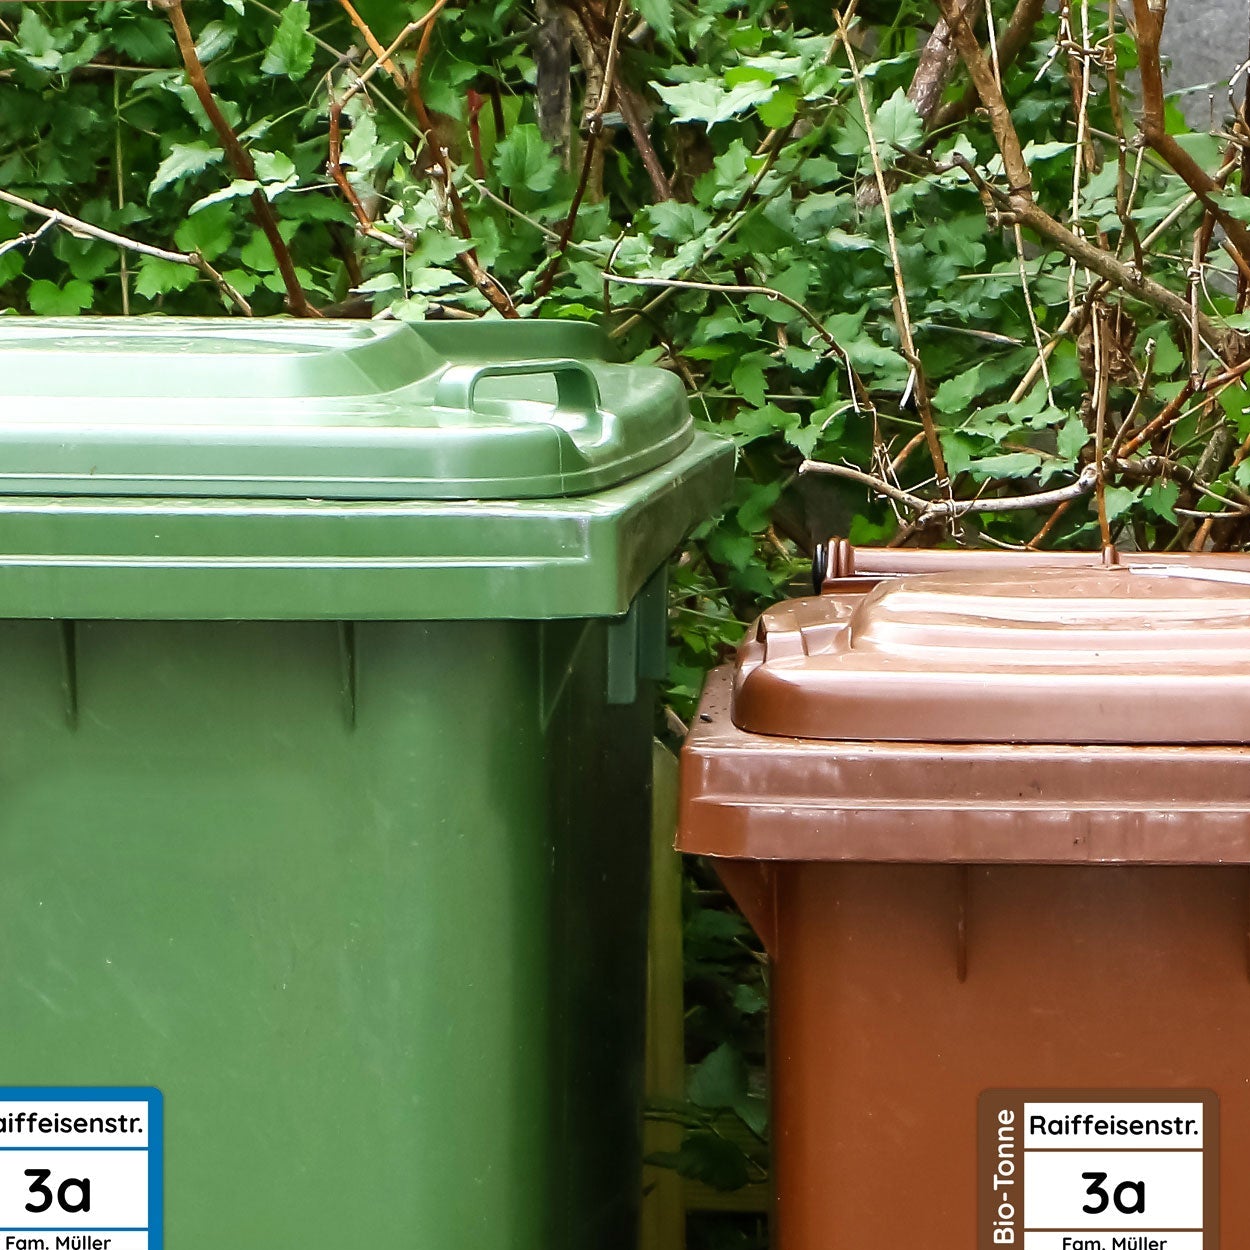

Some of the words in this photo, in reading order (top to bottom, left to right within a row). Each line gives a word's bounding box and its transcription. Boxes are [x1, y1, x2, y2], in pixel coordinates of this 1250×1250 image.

[1030, 1114, 1199, 1136] Raiffeisenstr.
[24, 1168, 91, 1214] 3a
[992, 1109, 1015, 1244] Bio-Tonne
[1081, 1171, 1146, 1215] 3a
[5, 1235, 50, 1250] Fam.
[55, 1235, 112, 1250] Müller
